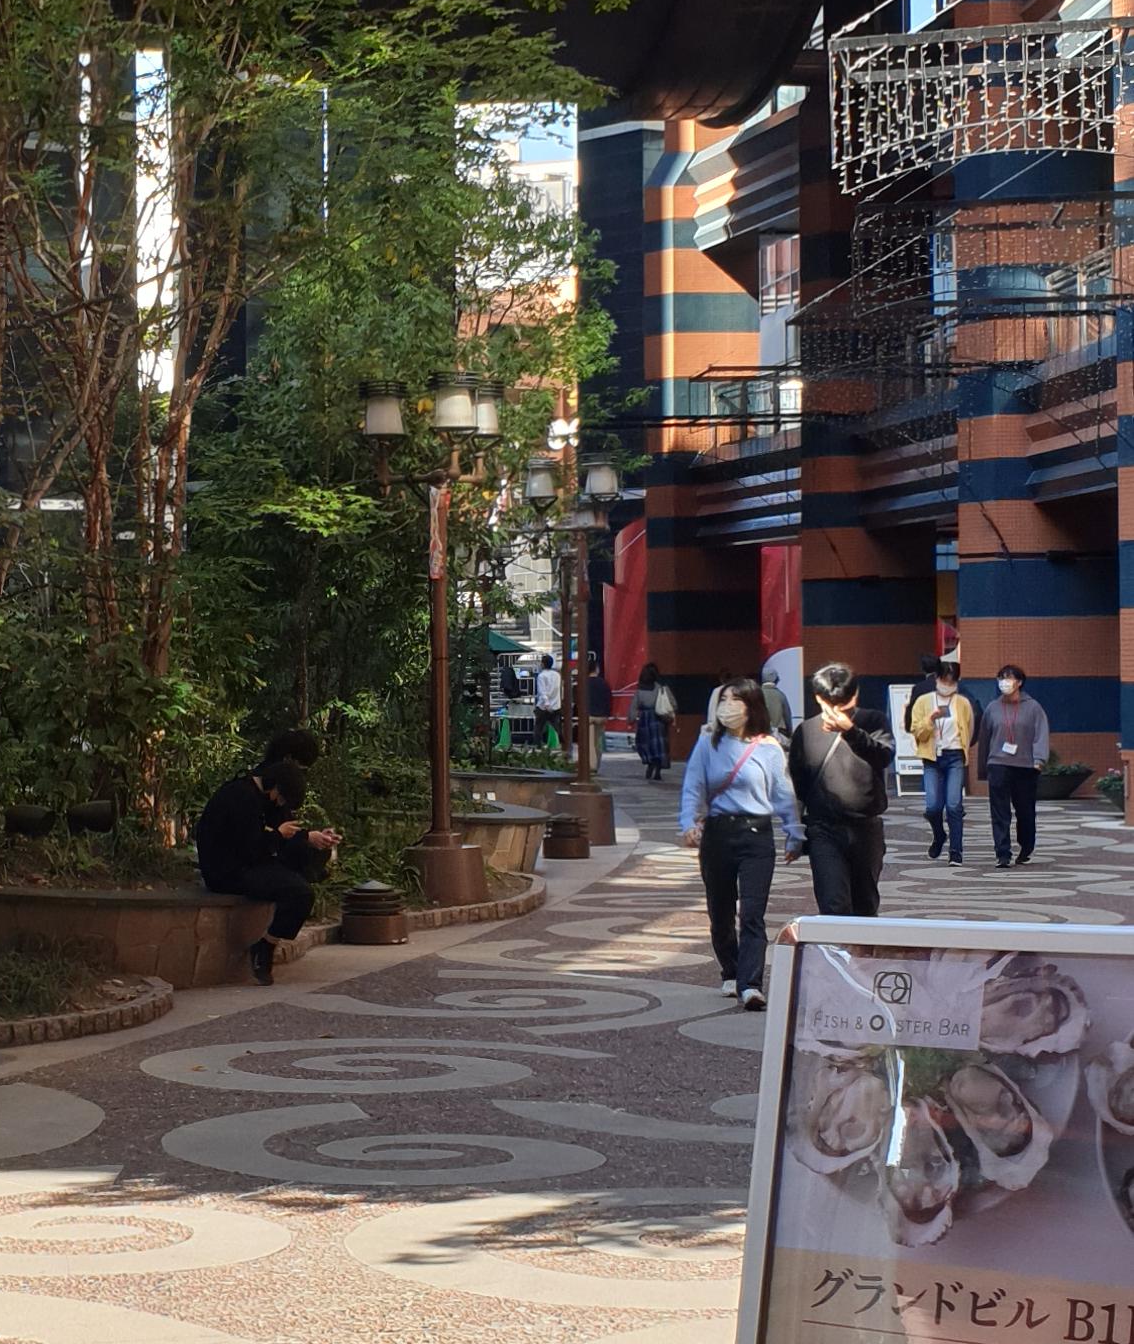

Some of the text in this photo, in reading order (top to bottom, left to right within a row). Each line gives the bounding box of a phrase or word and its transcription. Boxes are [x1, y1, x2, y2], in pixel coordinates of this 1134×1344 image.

[855, 1015, 863, 1031] &
[869, 1014, 931, 1034] OSTER
[811, 1268, 1051, 1330] グランドビル
